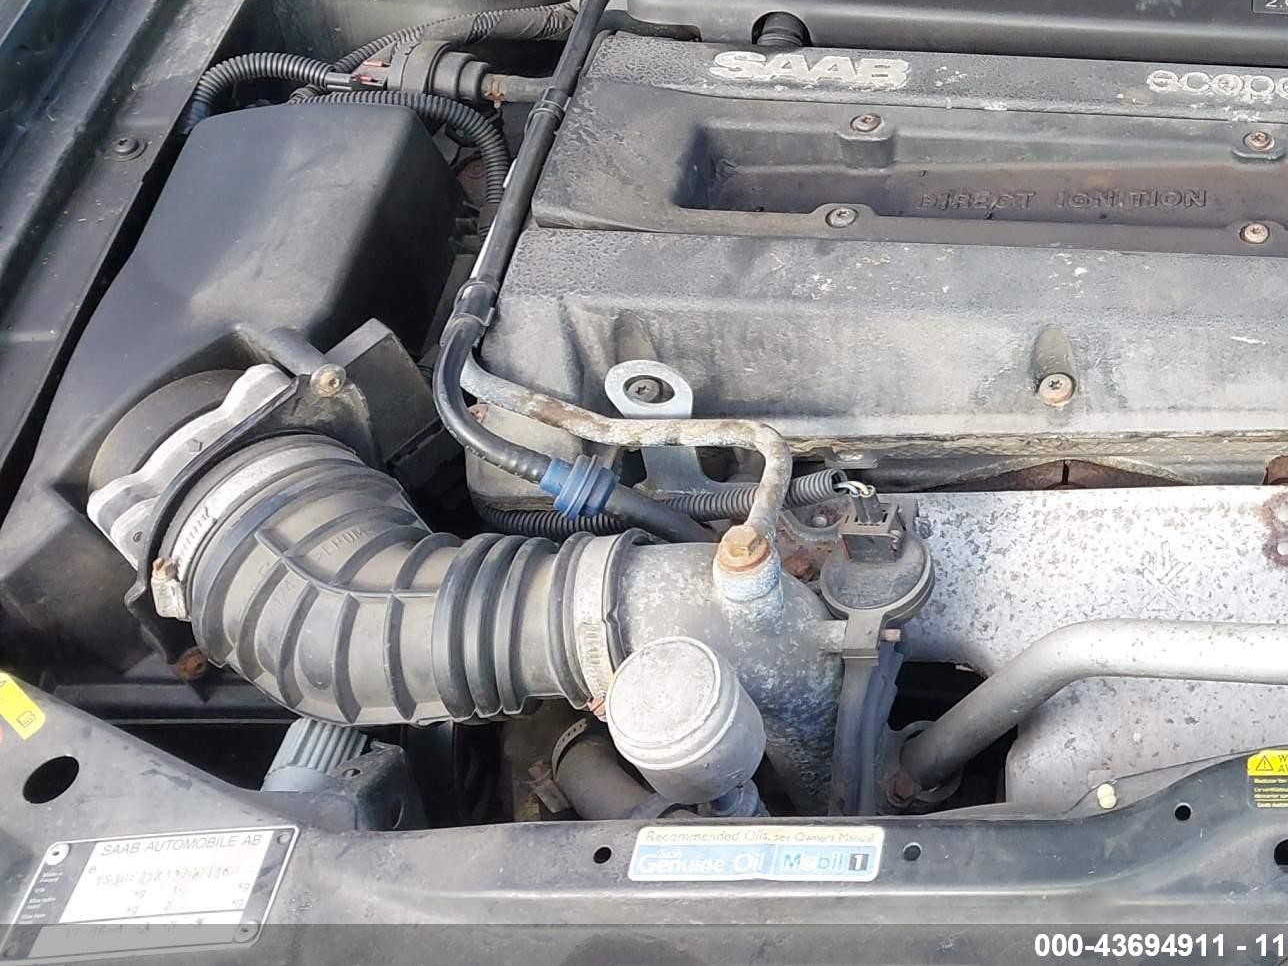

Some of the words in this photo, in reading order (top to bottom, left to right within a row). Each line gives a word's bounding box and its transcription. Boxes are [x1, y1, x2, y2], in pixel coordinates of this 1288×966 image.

[709, 50, 911, 90] SAAB
[915, 190, 1036, 211] DIRECT
[1057, 189, 1208, 209] IGNITION
[101, 842, 141, 856] SAAB
[144, 837, 236, 853] AUTOMOBILE
[242, 834, 263, 846] AB
[645, 830, 740, 843] Recommended
[839, 833, 875, 843] Manual
[638, 854, 726, 874] Genuine
[733, 853, 766, 873] Oil
[783, 852, 843, 871] Mobil
